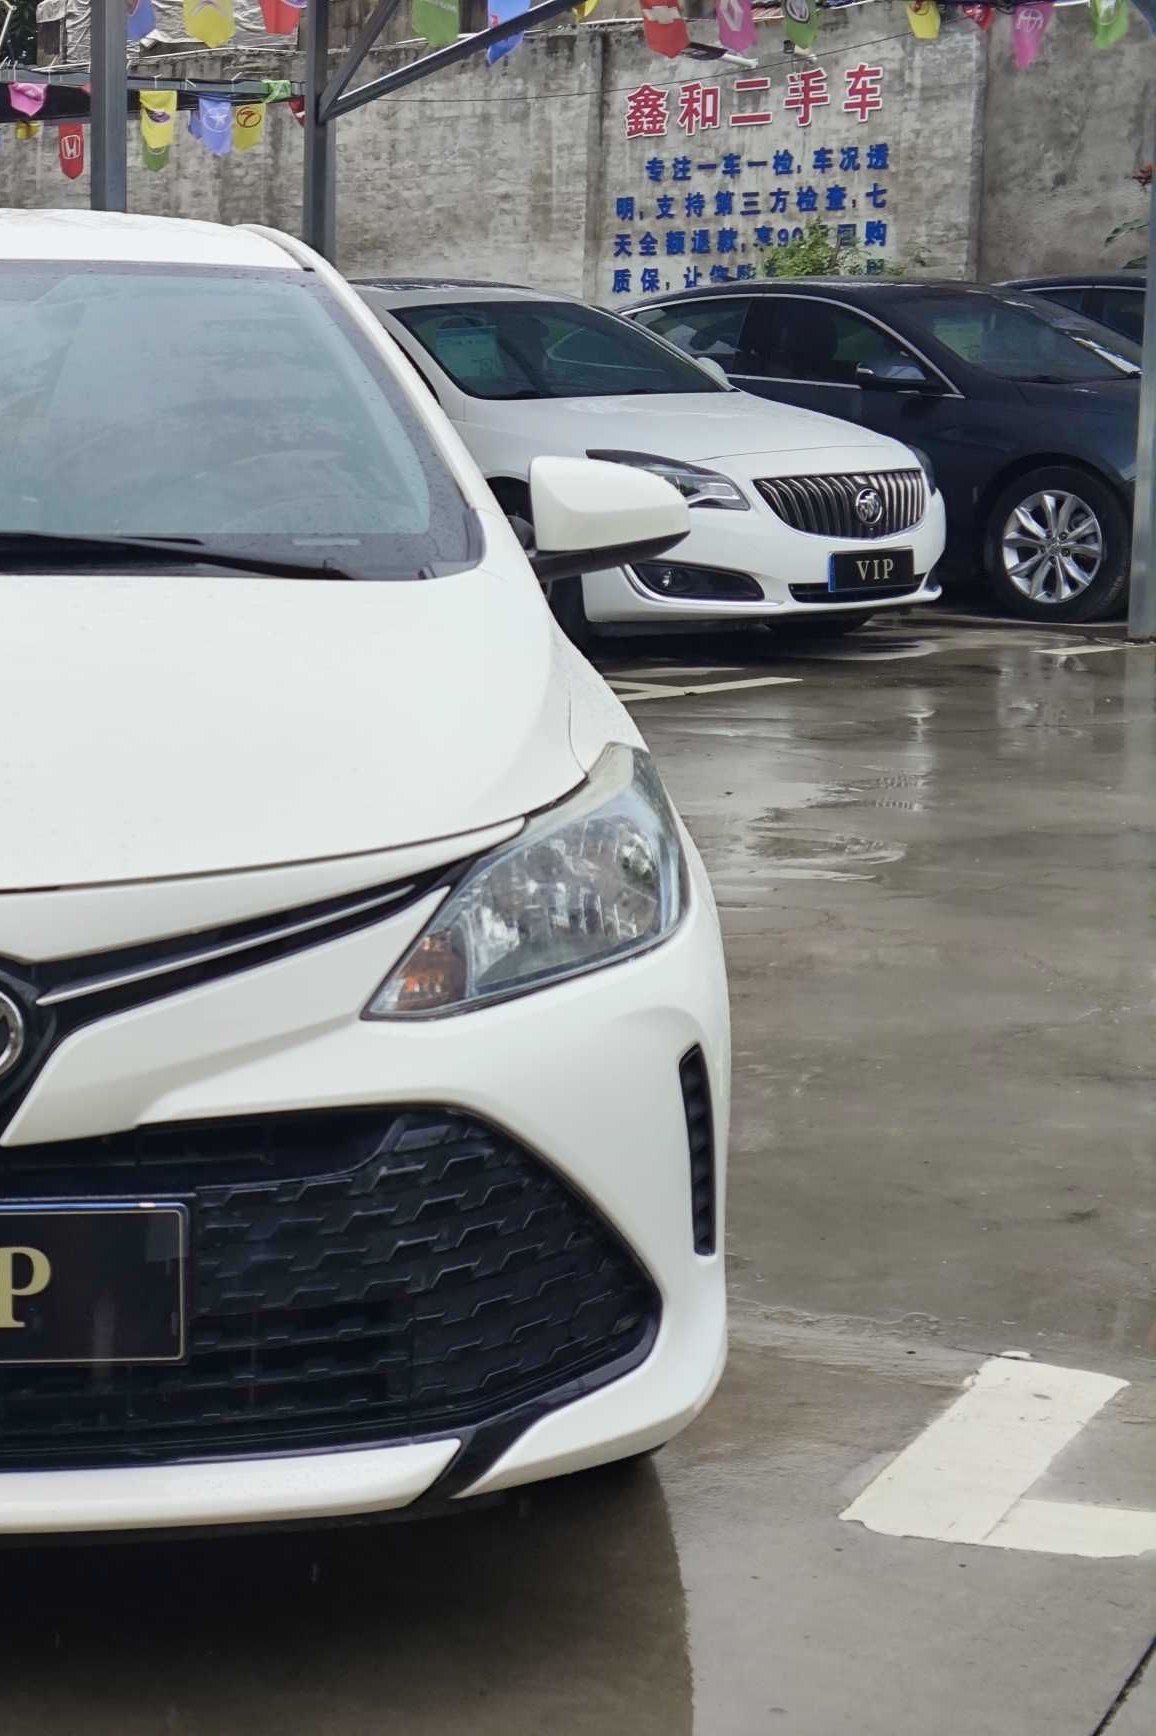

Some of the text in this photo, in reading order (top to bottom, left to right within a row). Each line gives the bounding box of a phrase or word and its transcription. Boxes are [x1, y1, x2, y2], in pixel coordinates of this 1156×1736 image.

[625, 63, 883, 139] 鑫和二手车
[856, 558, 894, 581] VIP
